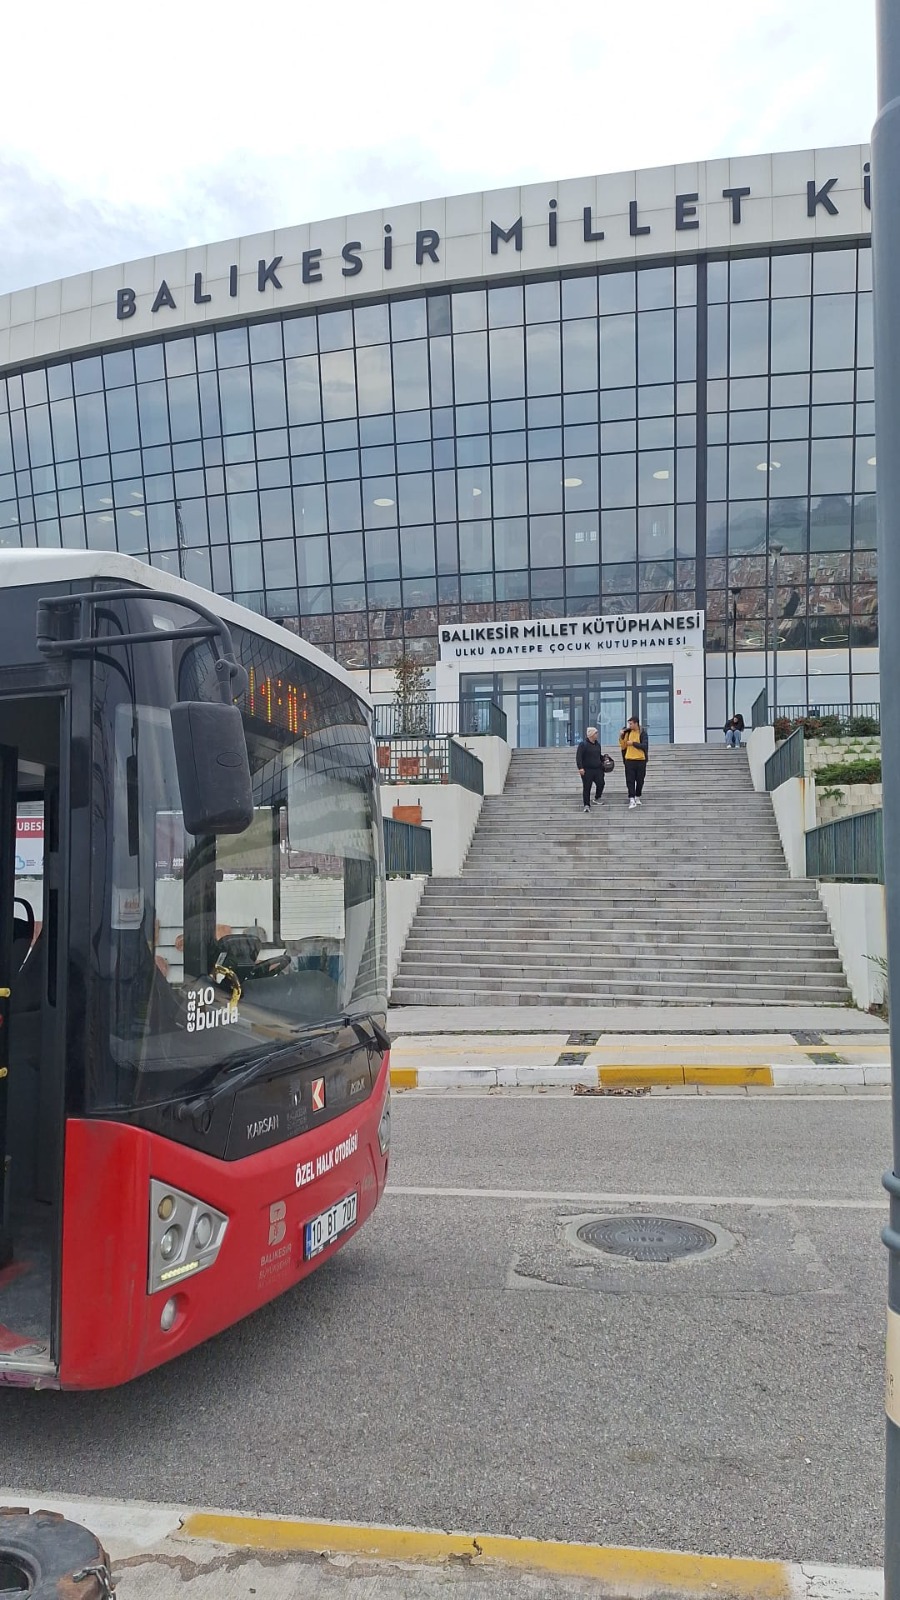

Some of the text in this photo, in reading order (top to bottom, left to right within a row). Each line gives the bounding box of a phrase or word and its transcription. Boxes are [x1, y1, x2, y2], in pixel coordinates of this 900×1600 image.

[117, 162, 871, 320] BALIKESİR MİLLET K
[442, 612, 700, 642] BALIKESİR MİLLET KÜTÜPHANESİ
[491, 645, 543, 655] ADATEPE
[549, 642, 591, 653] ÇOCUK
[197, 986, 215, 1007] 10
[186, 991, 196, 1033] esas
[196, 1002, 239, 1031] burda
[247, 1114, 279, 1140] KARSAN
[296, 1129, 358, 1188] ÖZEL HALK OTOBÜSÜ
[313, 1196, 356, 1247] 10 BT 707
